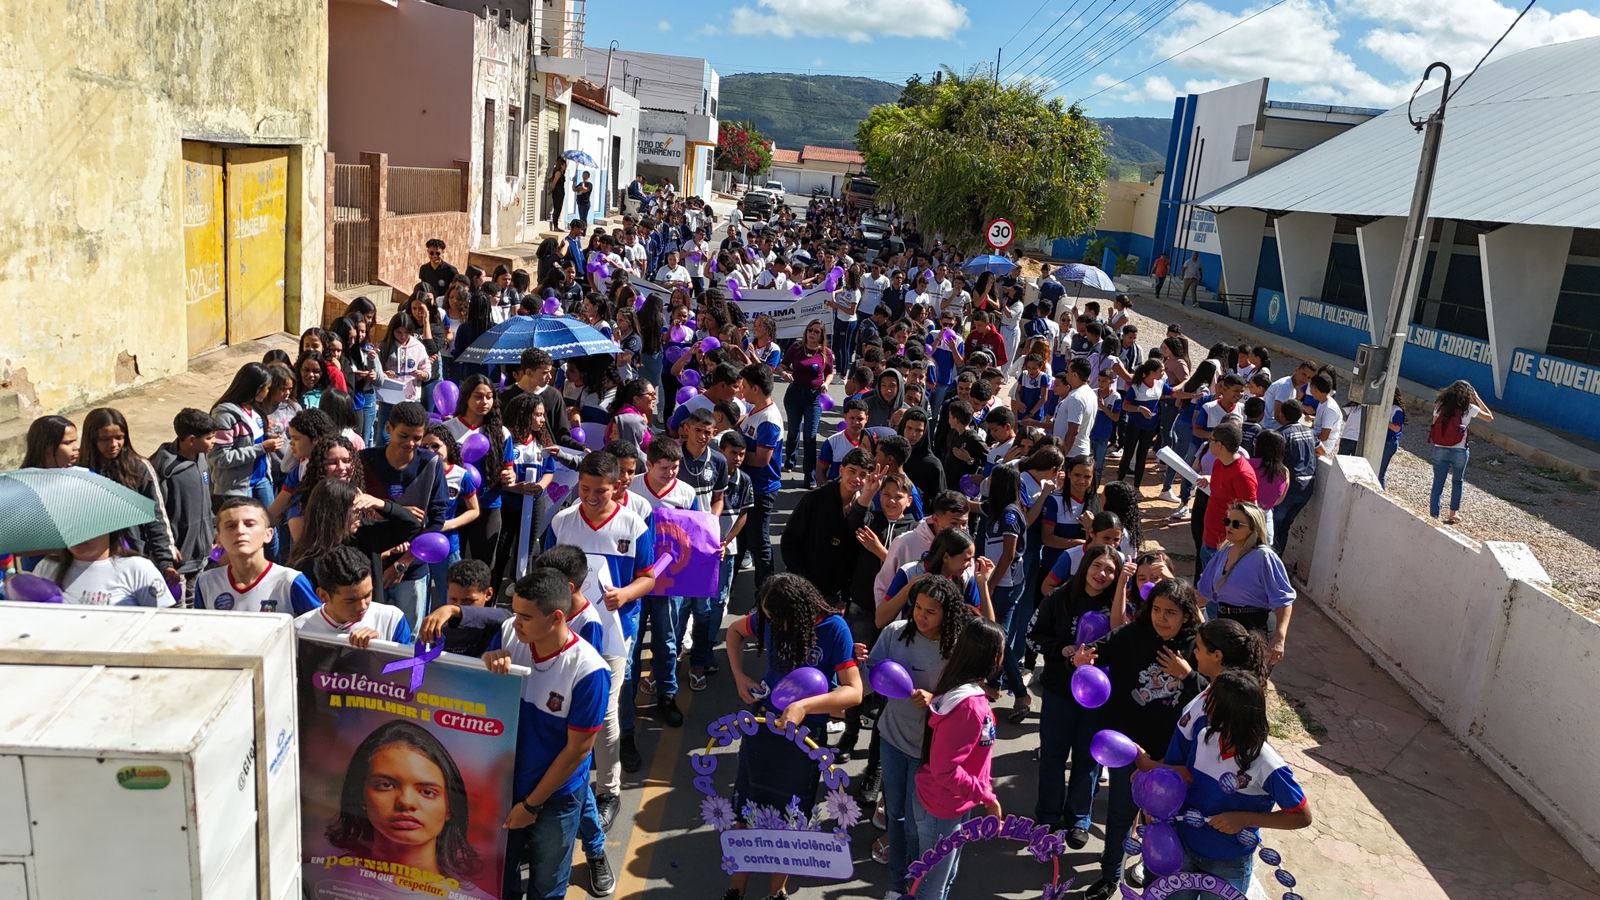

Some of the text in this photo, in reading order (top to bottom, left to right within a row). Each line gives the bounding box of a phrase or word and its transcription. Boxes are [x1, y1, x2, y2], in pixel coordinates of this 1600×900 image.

[638, 147, 681, 158] REINAMENTO
[655, 141, 664, 150] DE
[991, 225, 1010, 238] 30
[767, 308, 796, 318] LIMA
[1299, 299, 1370, 331] QUADRA POLIESPORTI
[1438, 333, 1492, 366] CORDEIR
[1512, 351, 1600, 396] DE SIQUEIR
[319, 673, 487, 715] violência CONTRA
[329, 694, 343, 708] A
[345, 696, 418, 719] MULHER
[441, 713, 500, 734] crime.
[728, 837, 843, 853] Pelo fim da violência
[310, 856, 325, 865] EM
[743, 855, 832, 869] contra a mulher
[359, 868, 377, 880] TEM
[377, 872, 395, 883] QUE
[398, 878, 445, 897] respeitar.
[1149, 873, 1217, 900] AGOSTO
